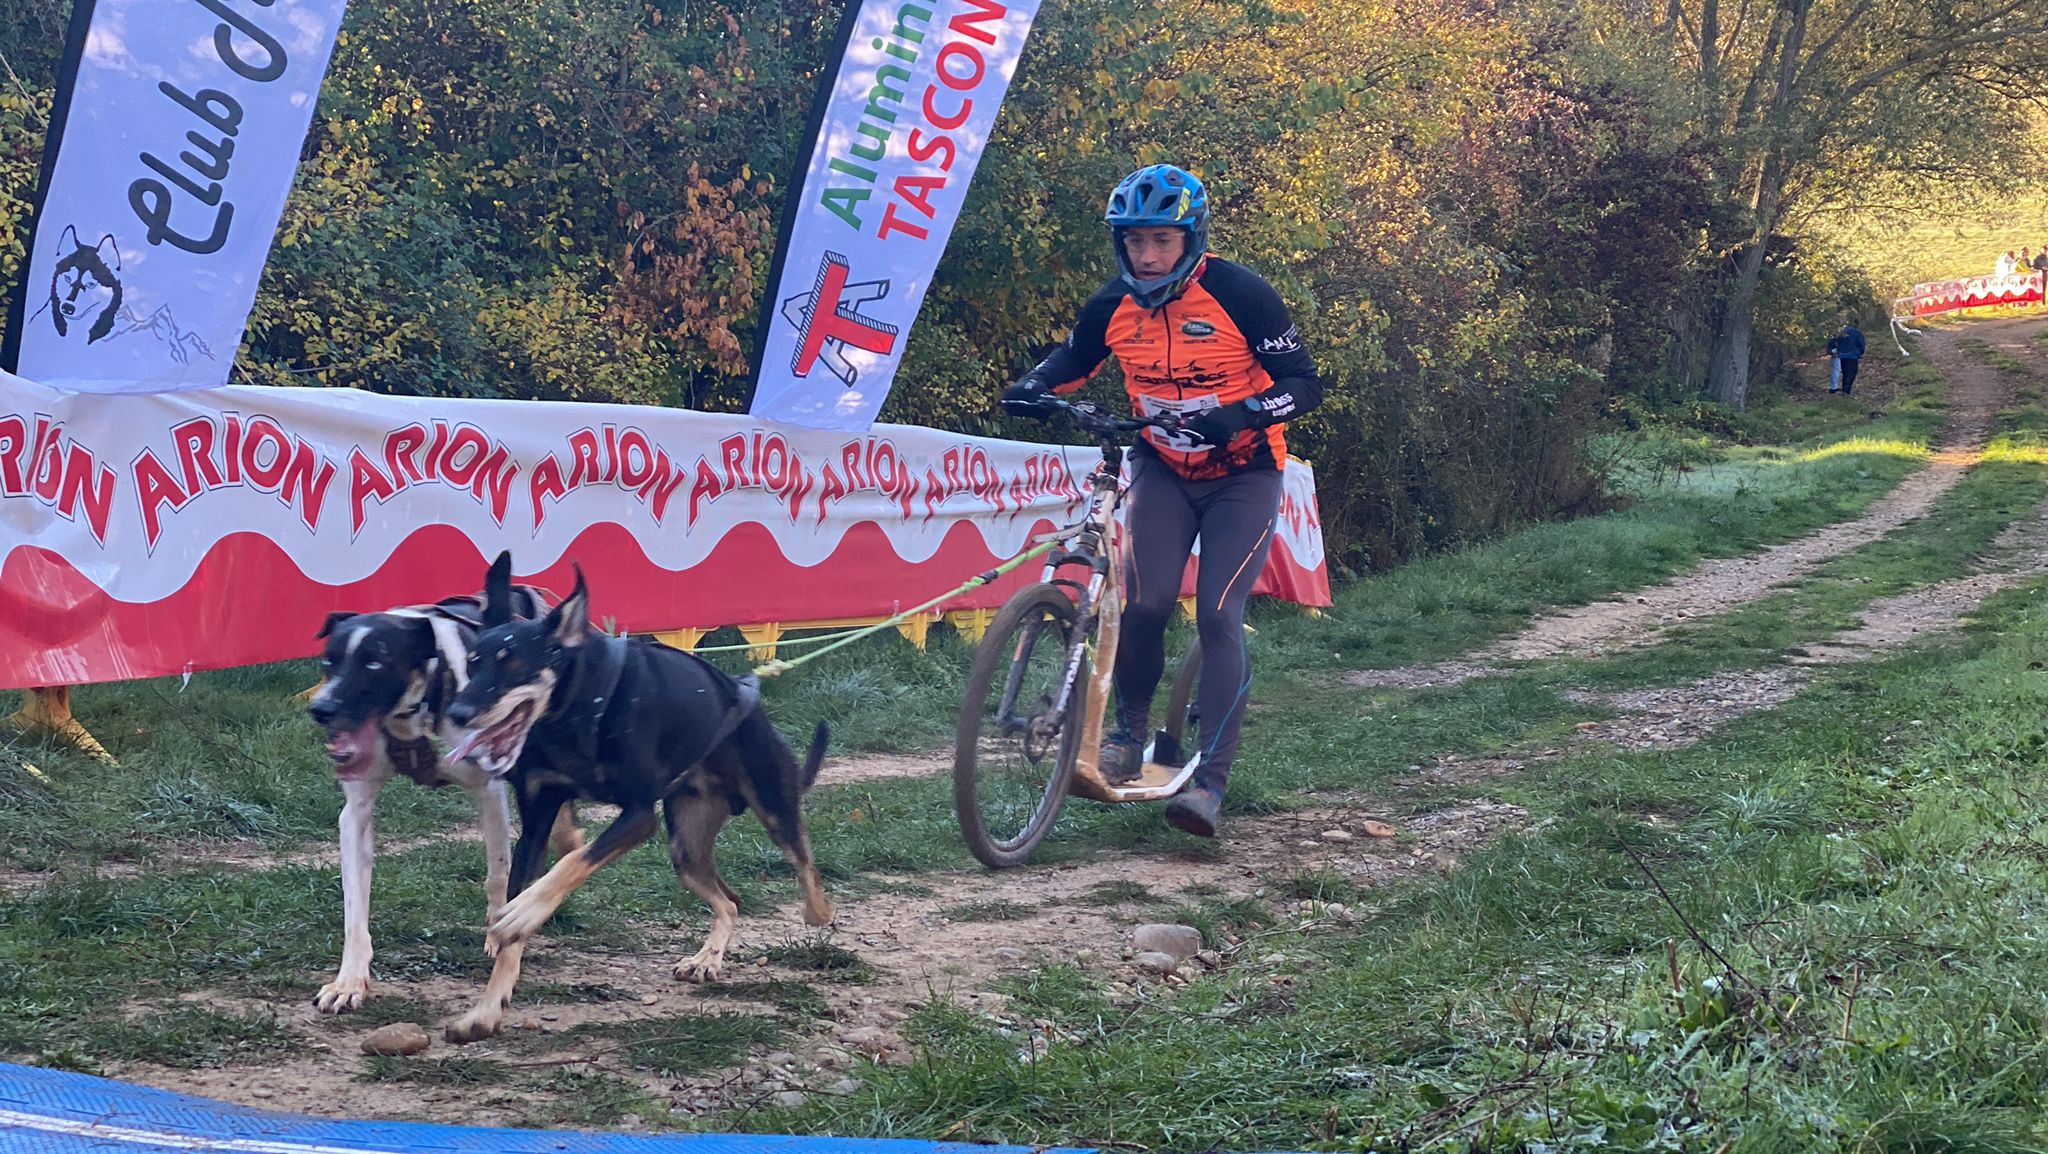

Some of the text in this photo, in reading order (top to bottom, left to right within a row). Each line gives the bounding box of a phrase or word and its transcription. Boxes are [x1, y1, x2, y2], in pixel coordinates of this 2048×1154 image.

[128, 81, 243, 254] Club
[820, 0, 937, 232] Alumin
[0, 411, 1085, 558] RION ARION ARION ARION ARION ARION ARION ARION
